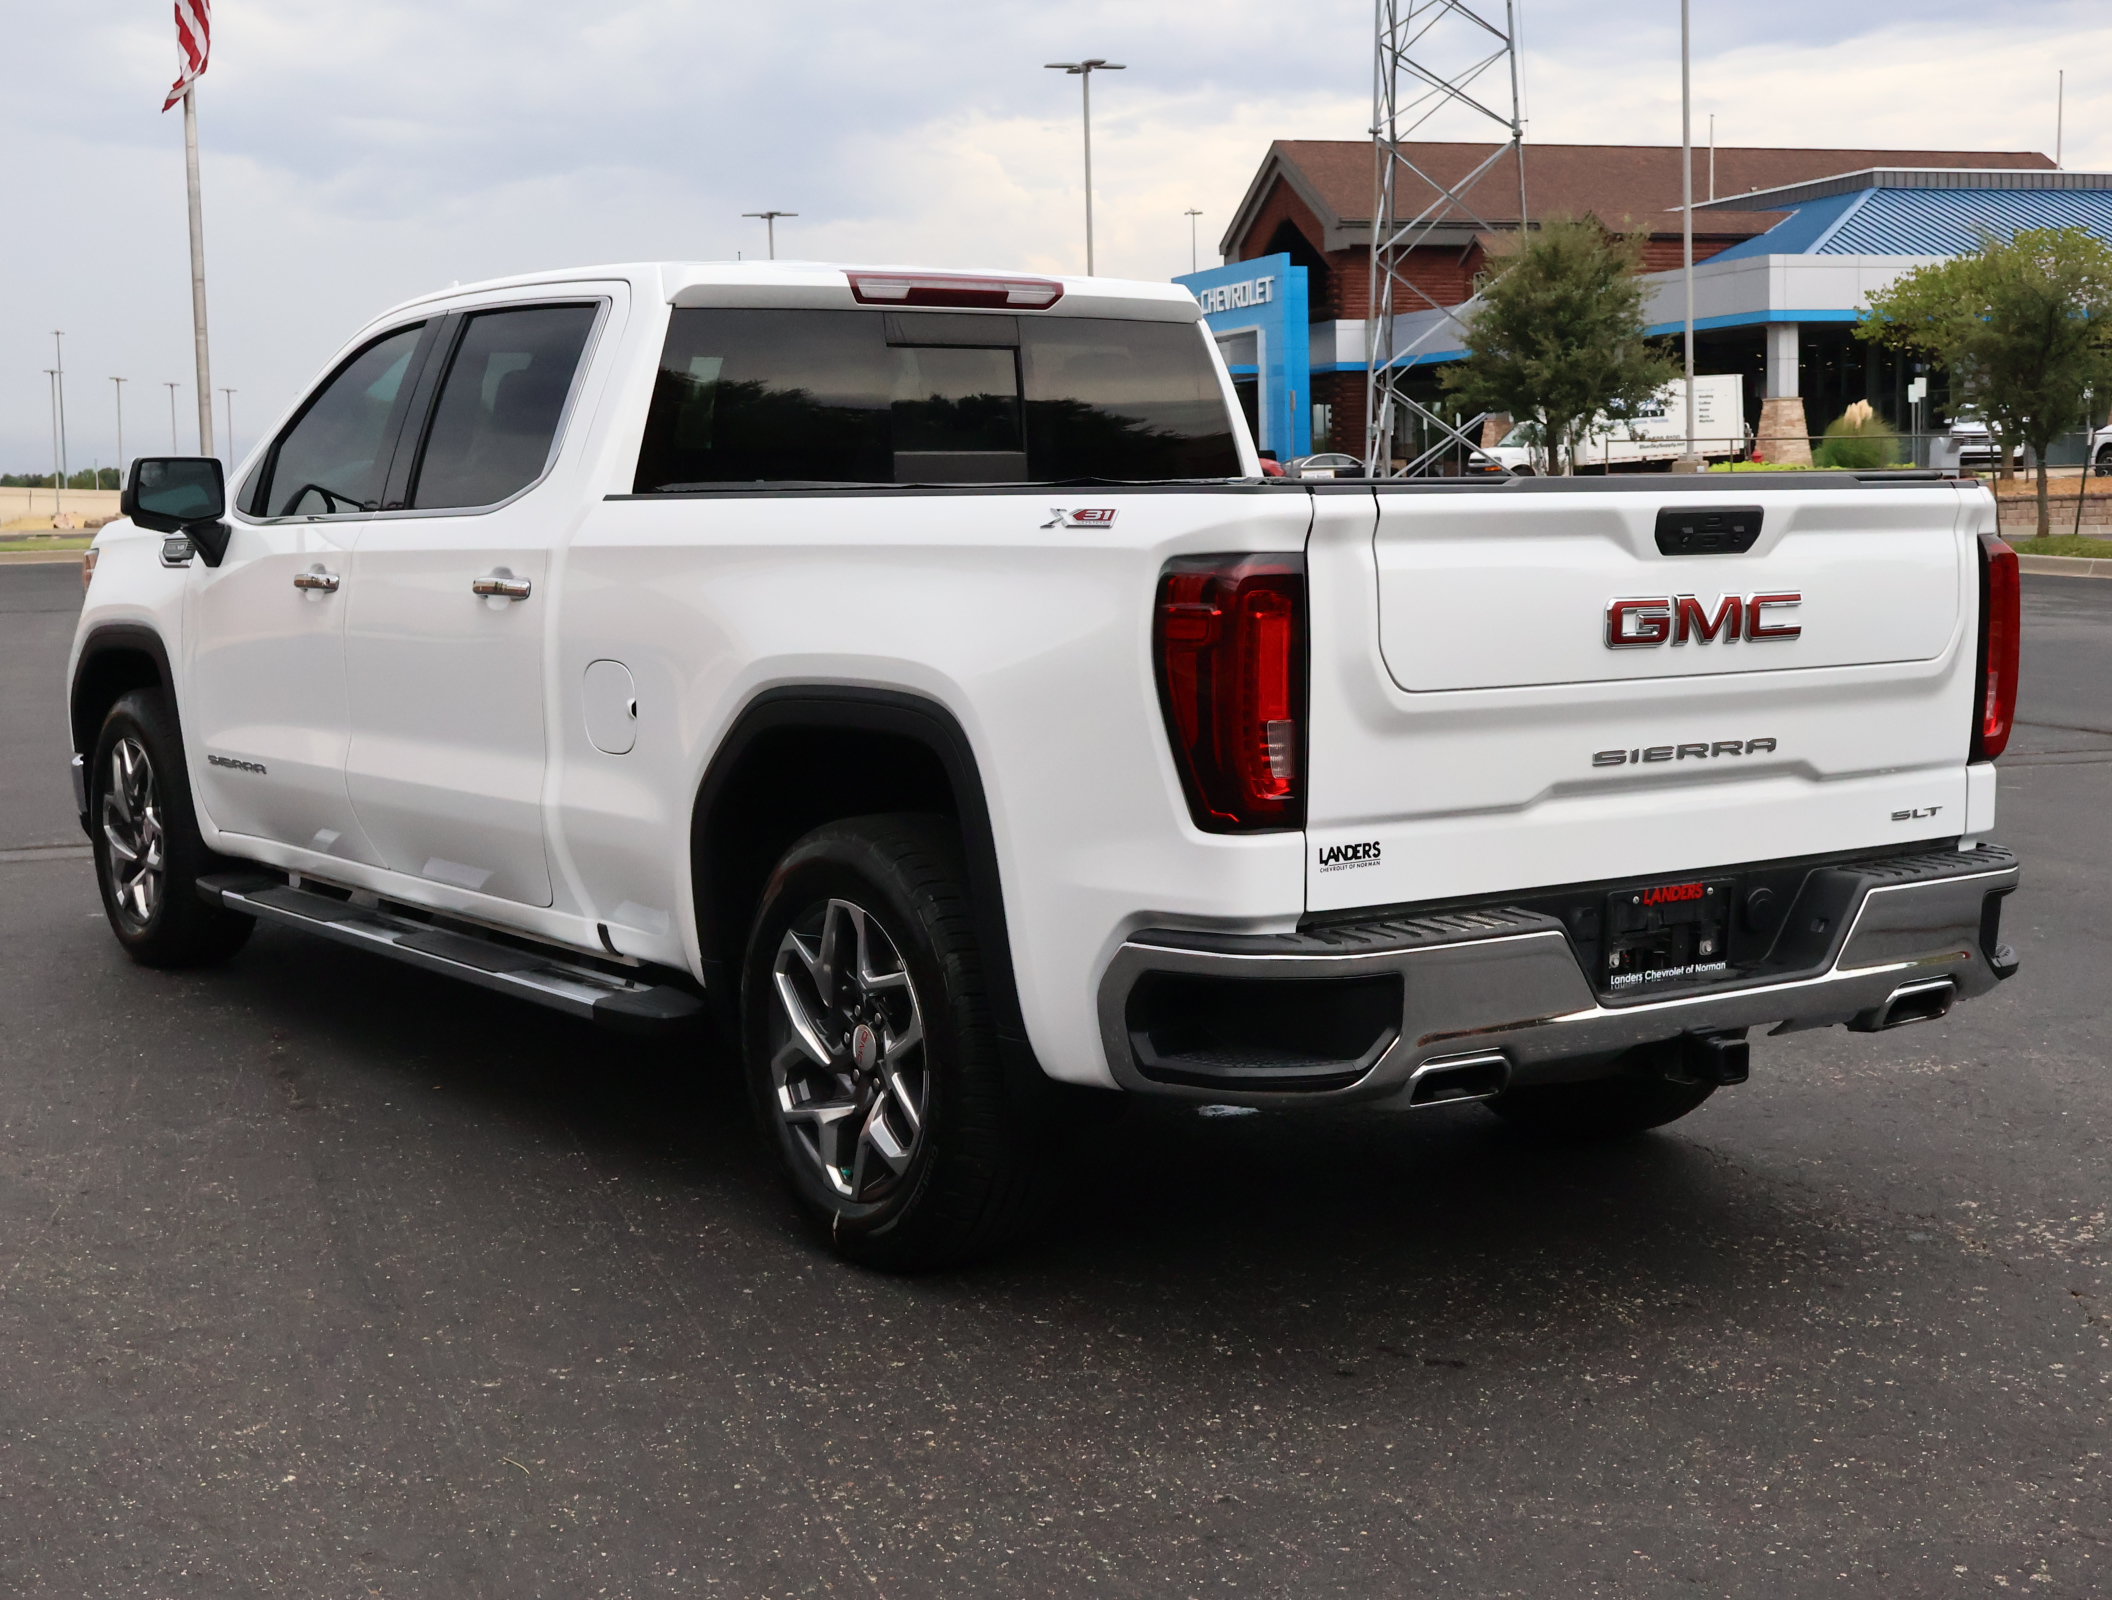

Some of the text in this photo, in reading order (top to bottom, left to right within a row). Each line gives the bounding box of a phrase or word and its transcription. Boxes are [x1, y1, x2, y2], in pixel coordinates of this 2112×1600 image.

[1201, 275, 1275, 315] CHEVROLET
[1603, 590, 1802, 650] GMC
[207, 754, 267, 774] SIERRA
[1592, 737, 1777, 767] SIERRA
[1891, 806, 1943, 821] SLT
[1319, 841, 1381, 866] LANDERS
[1319, 864, 1348, 873] CHEVROLET
[1643, 882, 1704, 907] LANDERS
[1611, 962, 1726, 985] Landers Chevrolet of Norman
